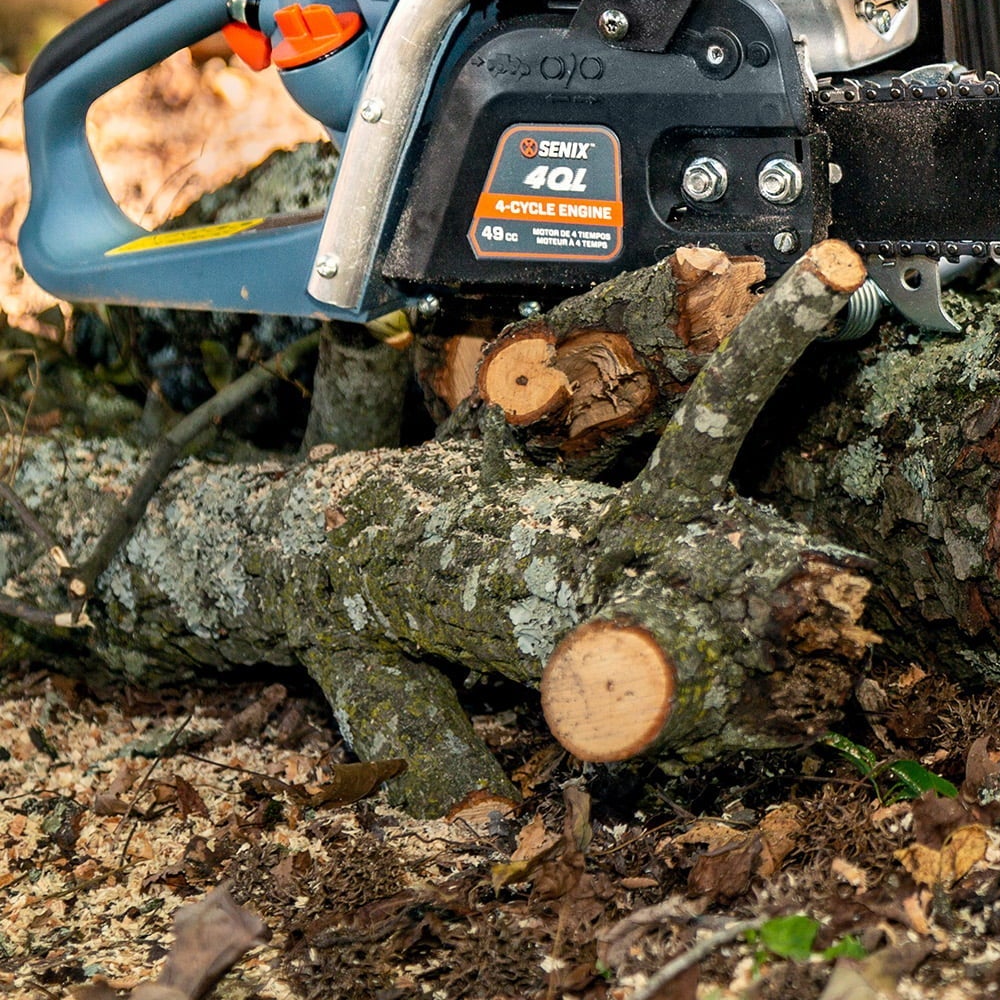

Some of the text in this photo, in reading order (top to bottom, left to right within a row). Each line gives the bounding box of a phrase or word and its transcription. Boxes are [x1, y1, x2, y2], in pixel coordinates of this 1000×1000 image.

[538, 141, 590, 159] SENIX
[523, 165, 587, 192] 4QL
[495, 200, 612, 220] 4-CYCLE ENGINE
[481, 225, 504, 242] 49
[532, 227, 611, 241] MOTOR DE 4 TIEMPOS
[536, 237, 568, 246] MOTEUR
[576, 239, 581, 247] 4
[582, 240, 608, 249] TEMPS
